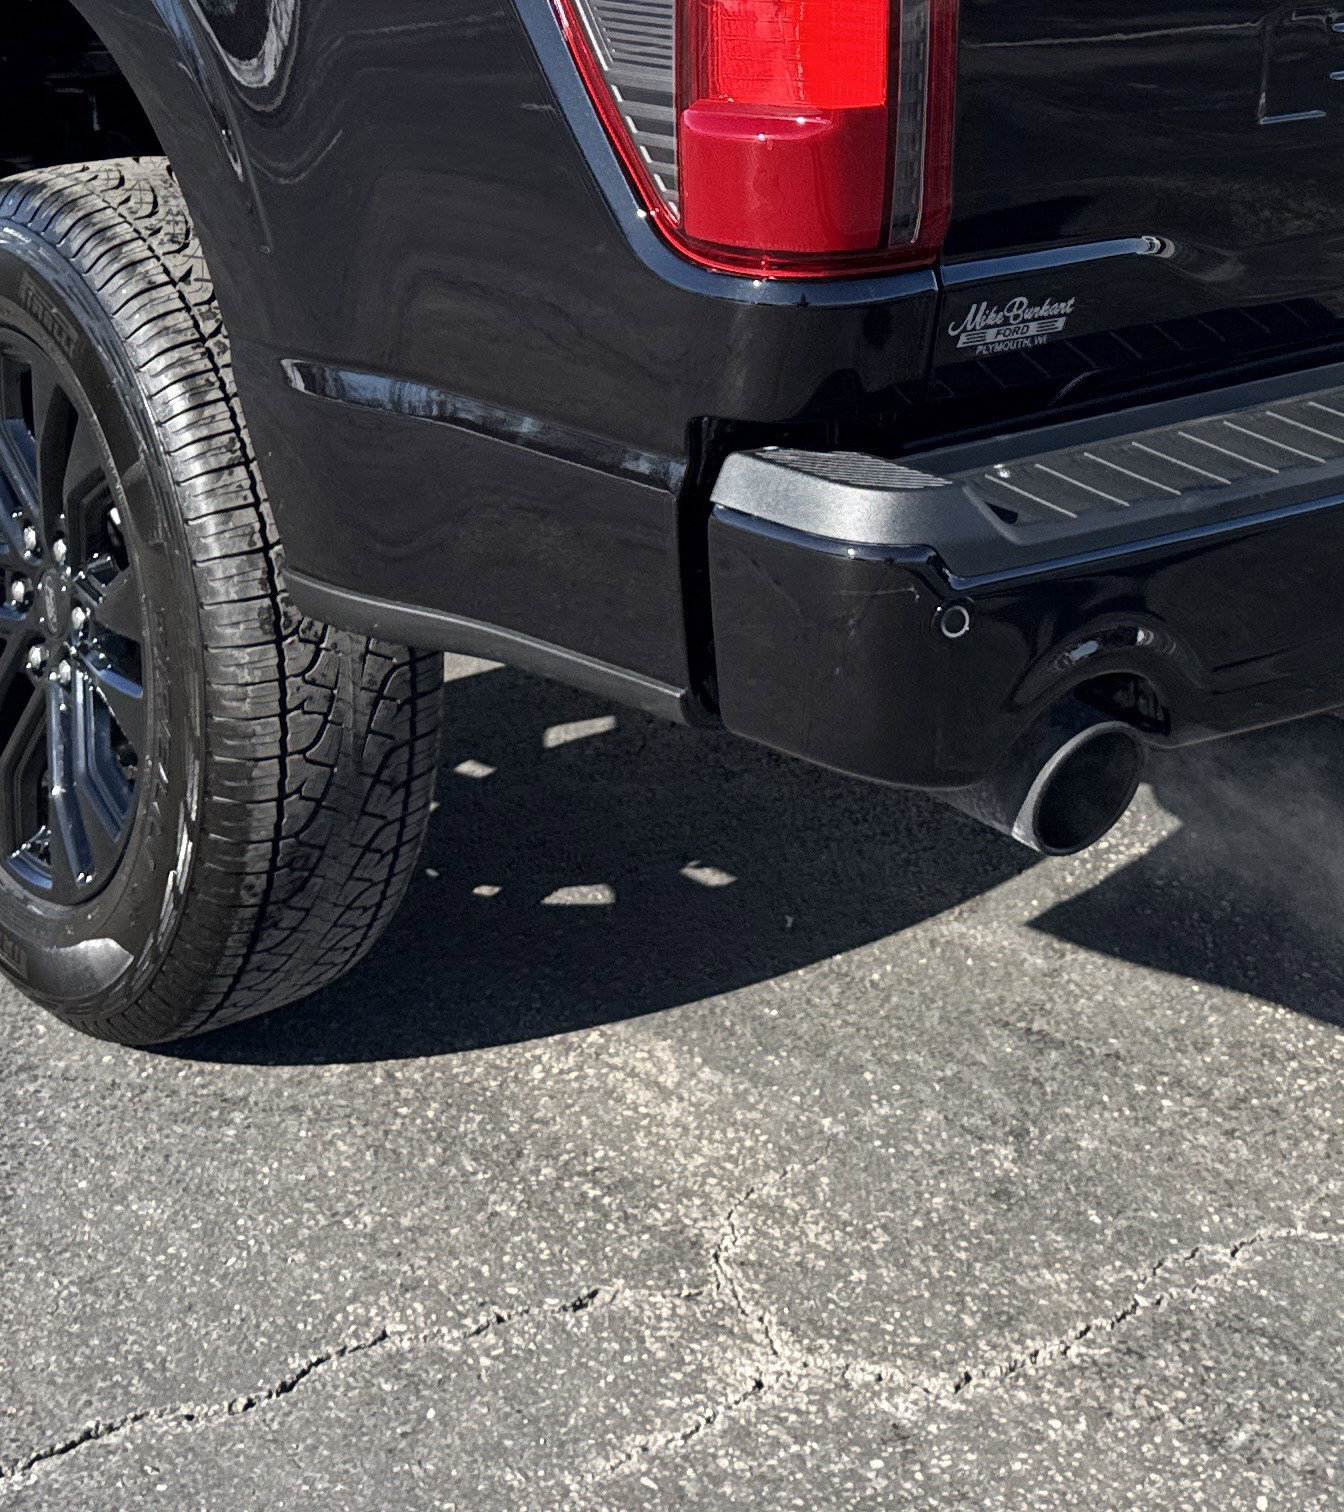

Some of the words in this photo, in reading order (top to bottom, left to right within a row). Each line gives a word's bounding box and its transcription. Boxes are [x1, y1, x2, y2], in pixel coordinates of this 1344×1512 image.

[948, 301, 1004, 336] Mike
[1004, 296, 1076, 324] Burkart
[995, 325, 1030, 339] FORD
